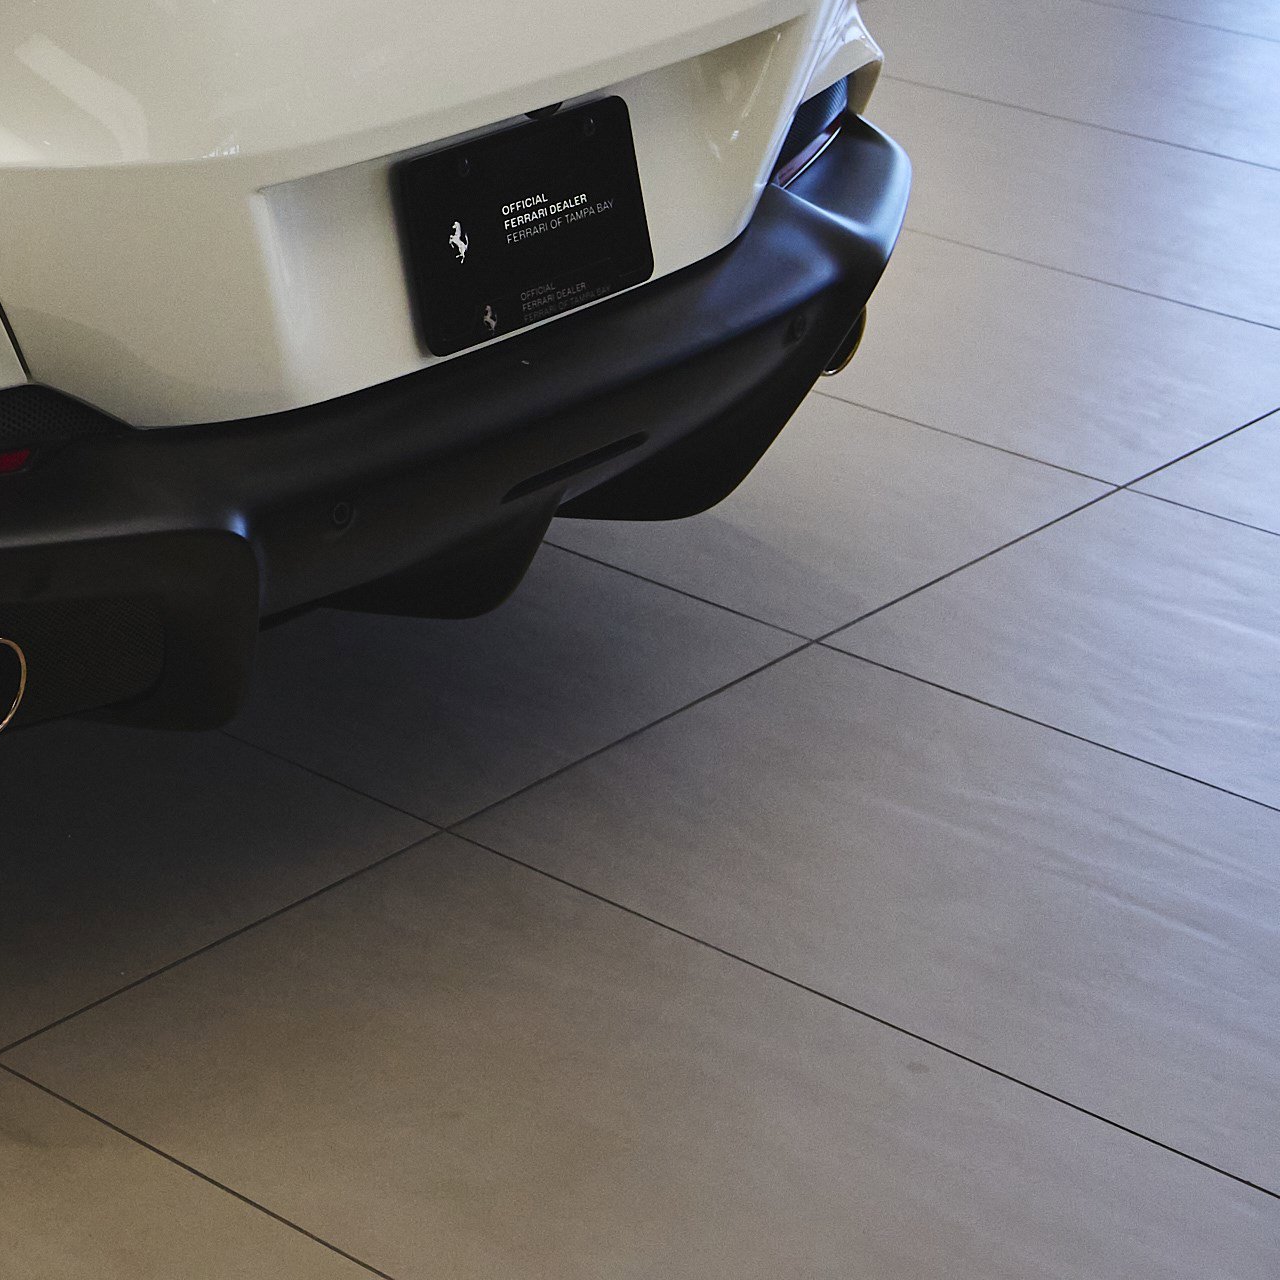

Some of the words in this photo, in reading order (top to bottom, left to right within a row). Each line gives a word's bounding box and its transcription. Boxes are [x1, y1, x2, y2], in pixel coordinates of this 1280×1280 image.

[502, 193, 549, 216] OFFICIAL
[504, 207, 548, 230] FERRARI
[549, 193, 588, 215] DEALER
[506, 222, 548, 244] FERRARI
[550, 216, 562, 229] OF
[565, 206, 596, 224] TAMPA
[596, 199, 615, 213] BAY
[520, 282, 556, 301] OFFICIAL
[556, 282, 586, 300] DEALER
